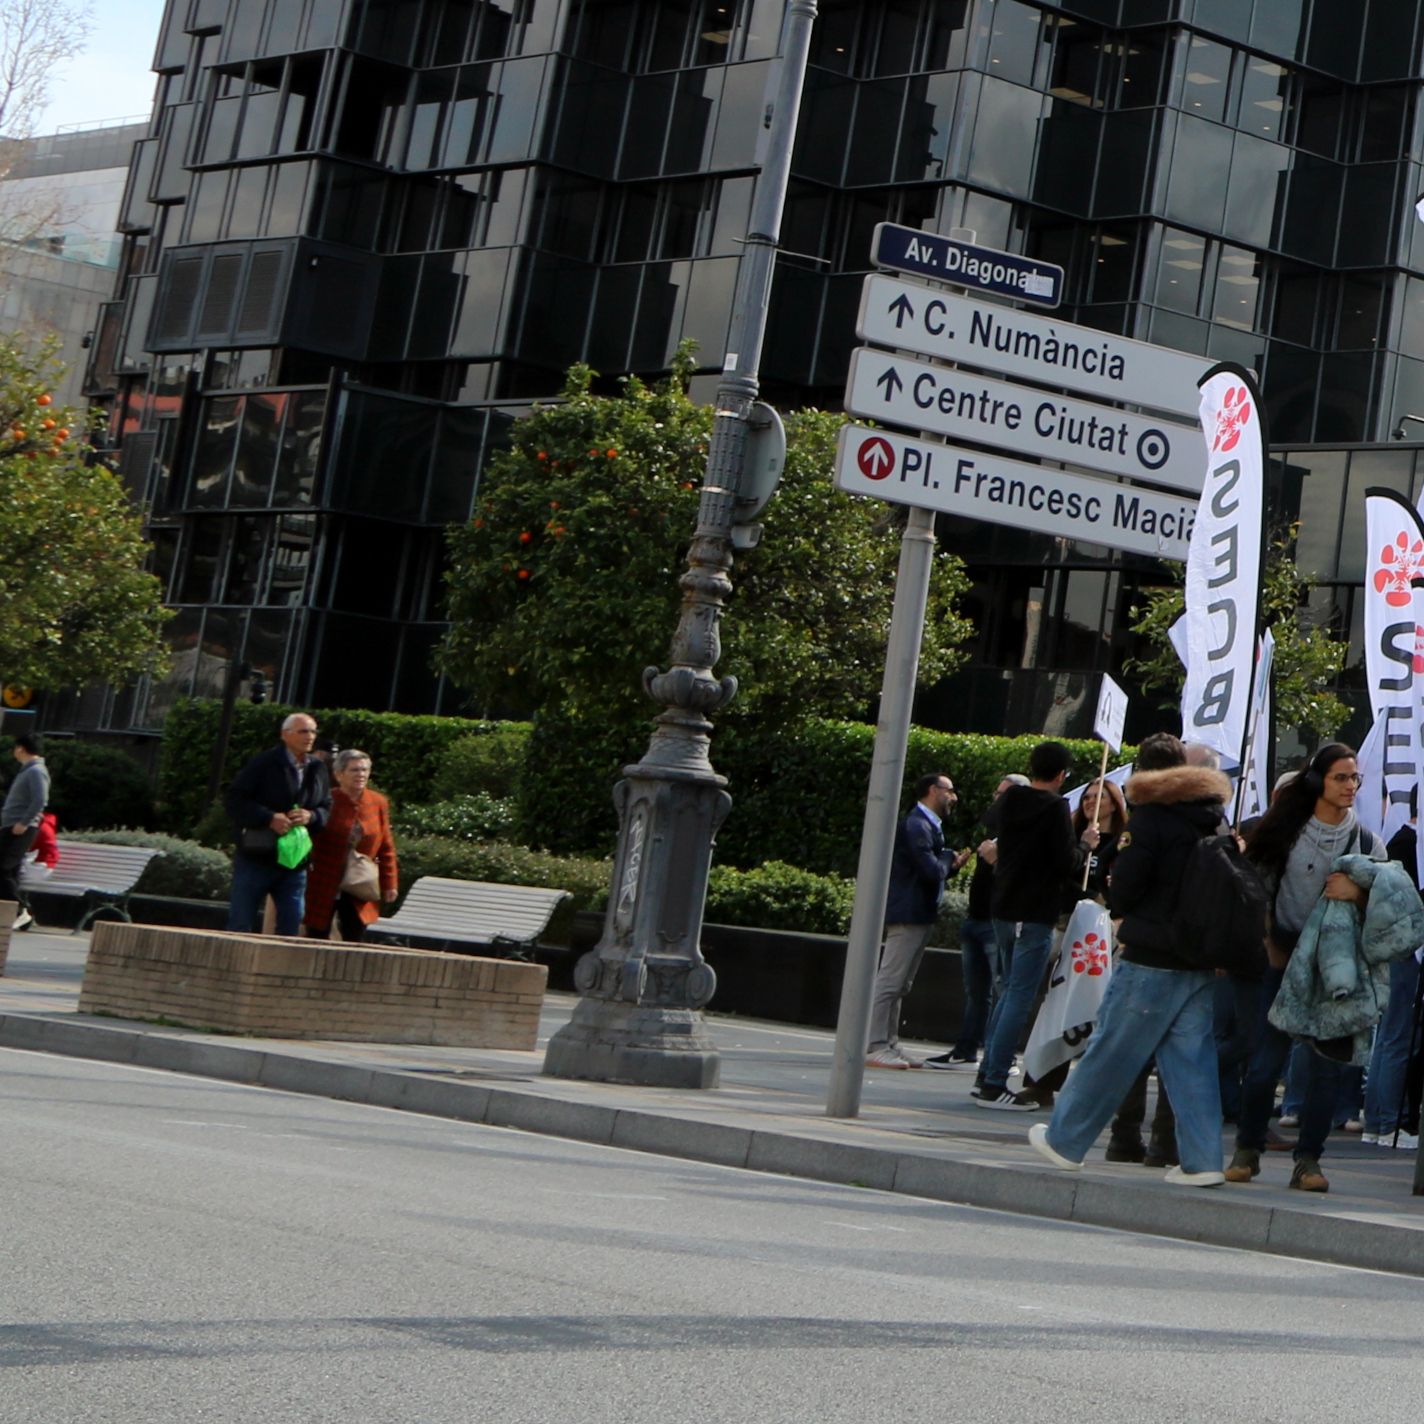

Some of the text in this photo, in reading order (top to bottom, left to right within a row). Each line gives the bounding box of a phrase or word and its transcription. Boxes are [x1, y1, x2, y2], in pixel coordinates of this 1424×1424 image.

[904, 237, 937, 267] Av.
[924, 299, 1126, 380] C. Numància
[913, 372, 1128, 456] Centre Ciutat
[900, 448, 940, 490] Pl.
[954, 460, 1100, 523] Francesc
